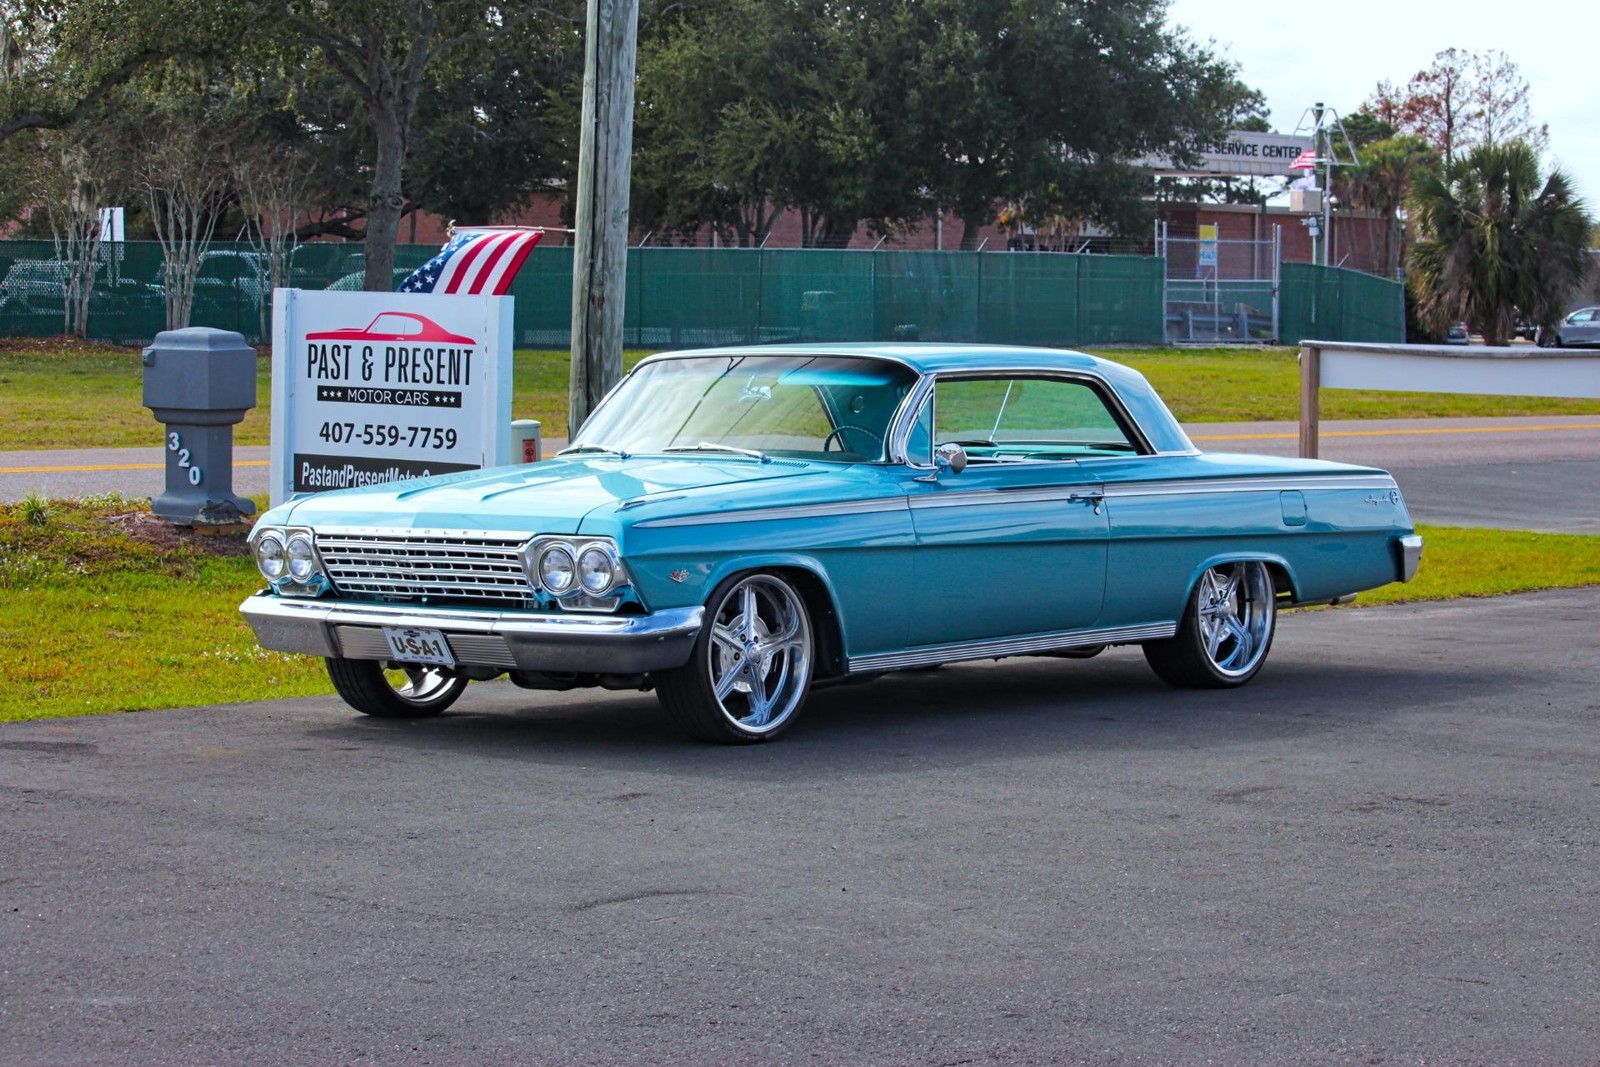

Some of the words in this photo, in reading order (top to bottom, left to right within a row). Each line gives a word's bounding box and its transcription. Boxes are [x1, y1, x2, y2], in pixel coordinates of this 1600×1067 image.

[1214, 141, 1259, 157] SERVICE
[1262, 145, 1302, 159] CENTER
[307, 343, 352, 380] PAST
[361, 345, 374, 381] &
[384, 346, 473, 386] PRESENT
[347, 389, 392, 404] MOTOR
[395, 392, 430, 406] CARS
[319, 421, 458, 450] 407-559-7759
[301, 461, 431, 489] PastandPresentMt
[345, 527, 488, 537] CHEOLET
